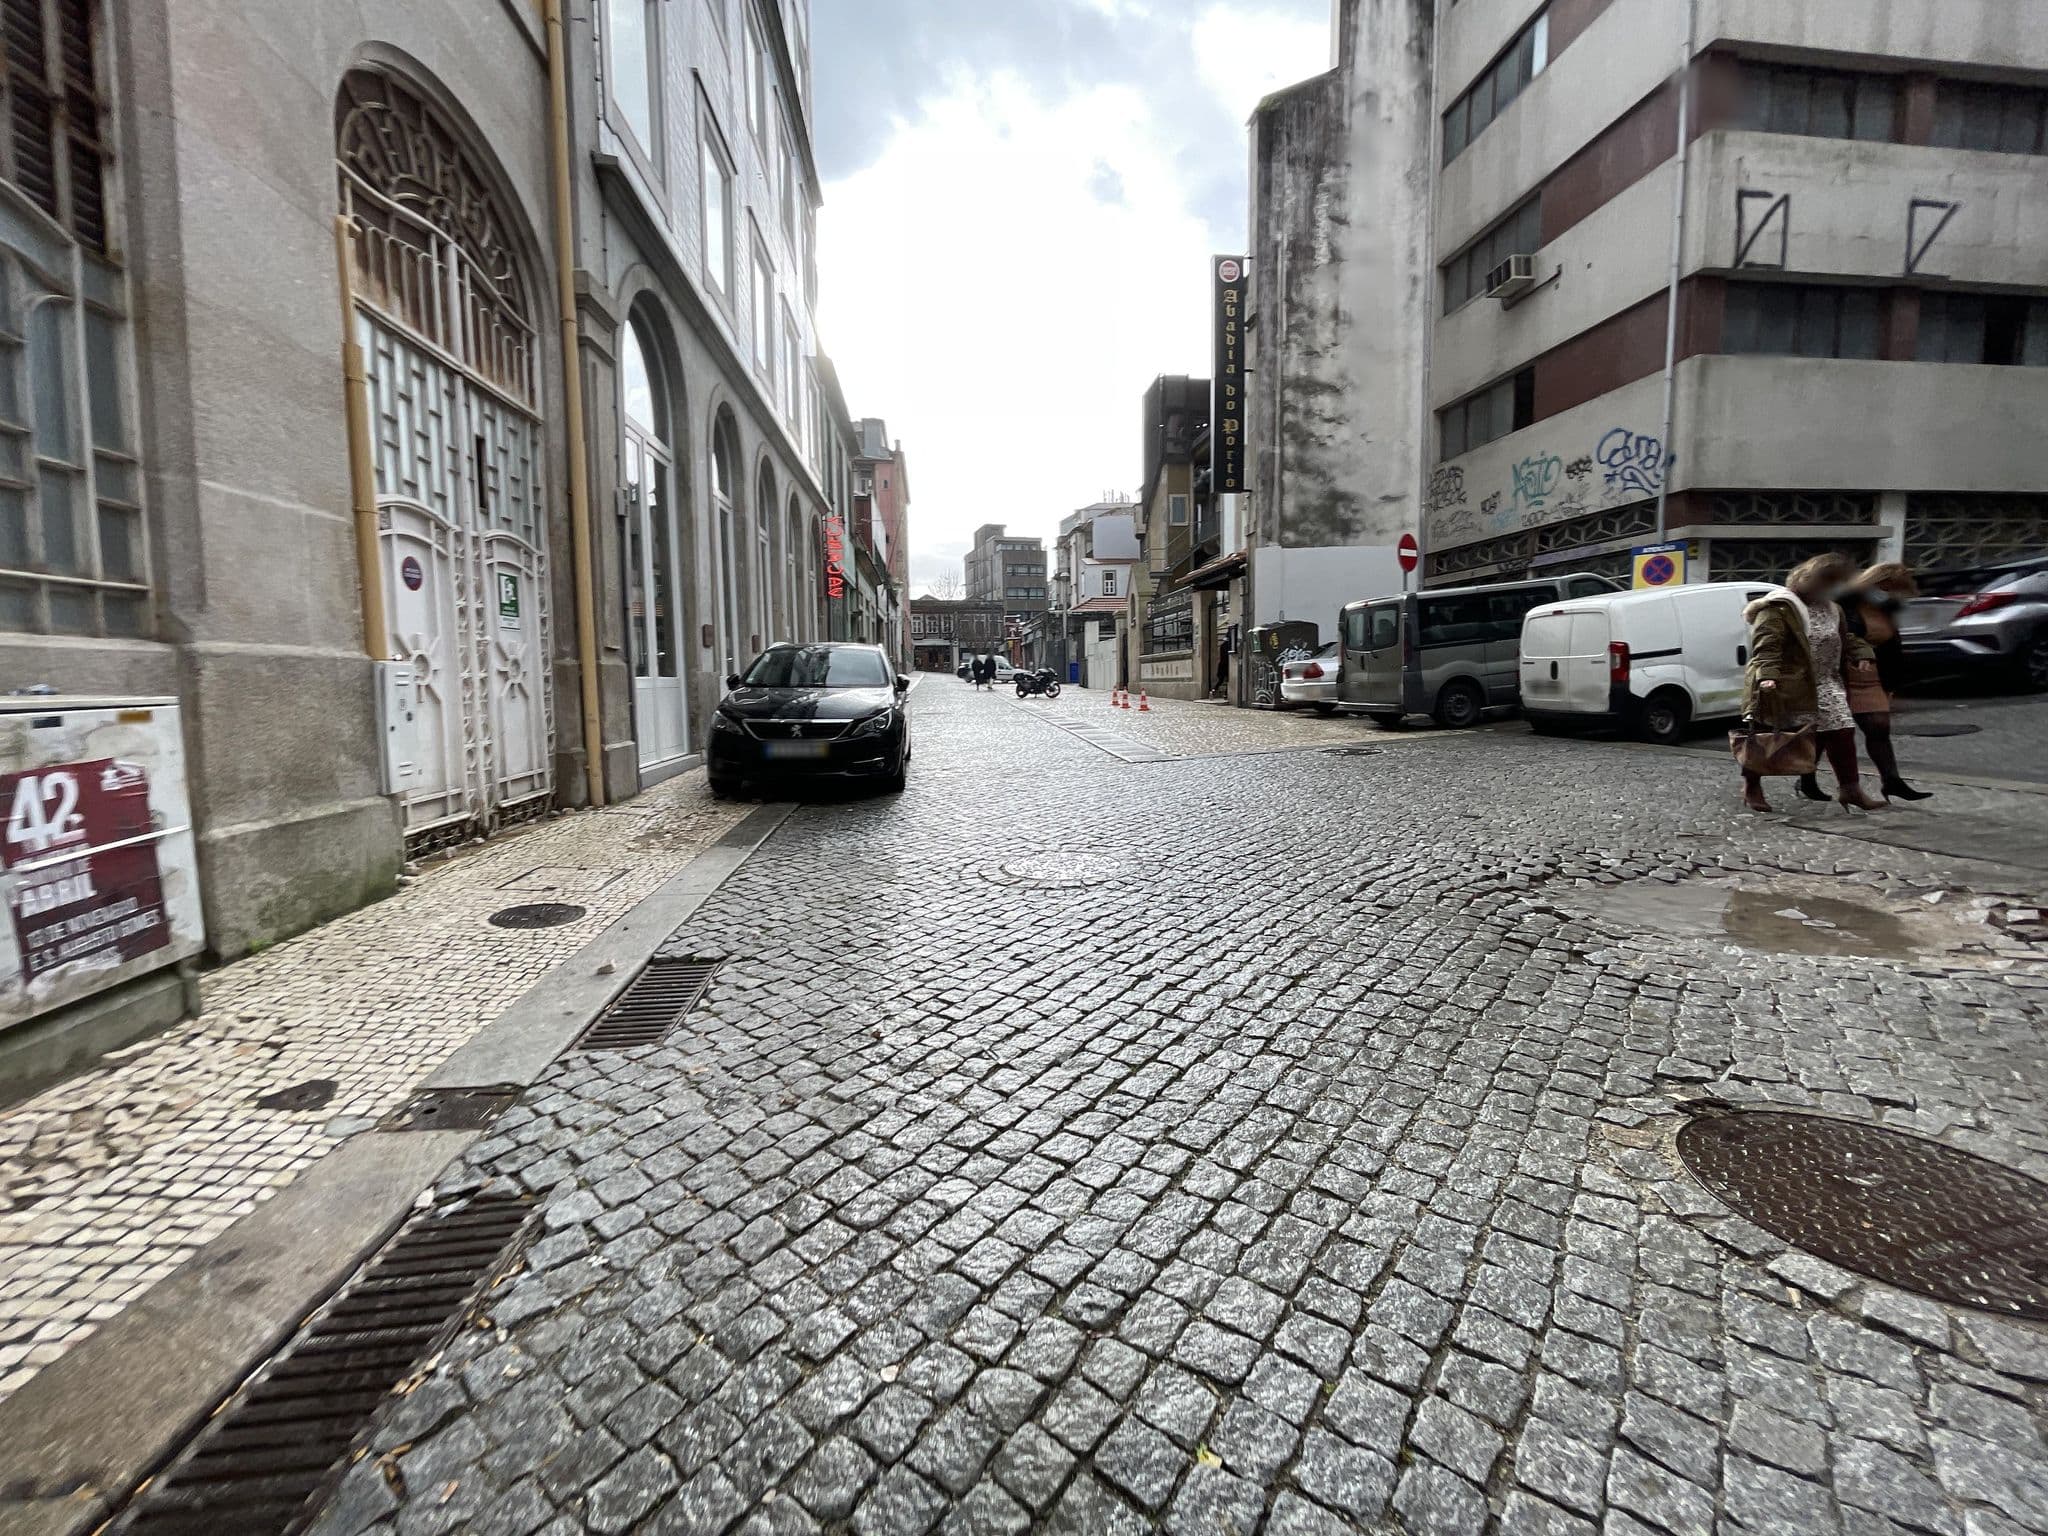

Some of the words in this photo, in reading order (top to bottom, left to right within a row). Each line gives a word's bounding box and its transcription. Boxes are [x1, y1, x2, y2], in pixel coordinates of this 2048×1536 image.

[1223, 289, 1239, 374] Abadia
[1225, 384, 1236, 411] do
[1222, 418, 1239, 488] Porto
